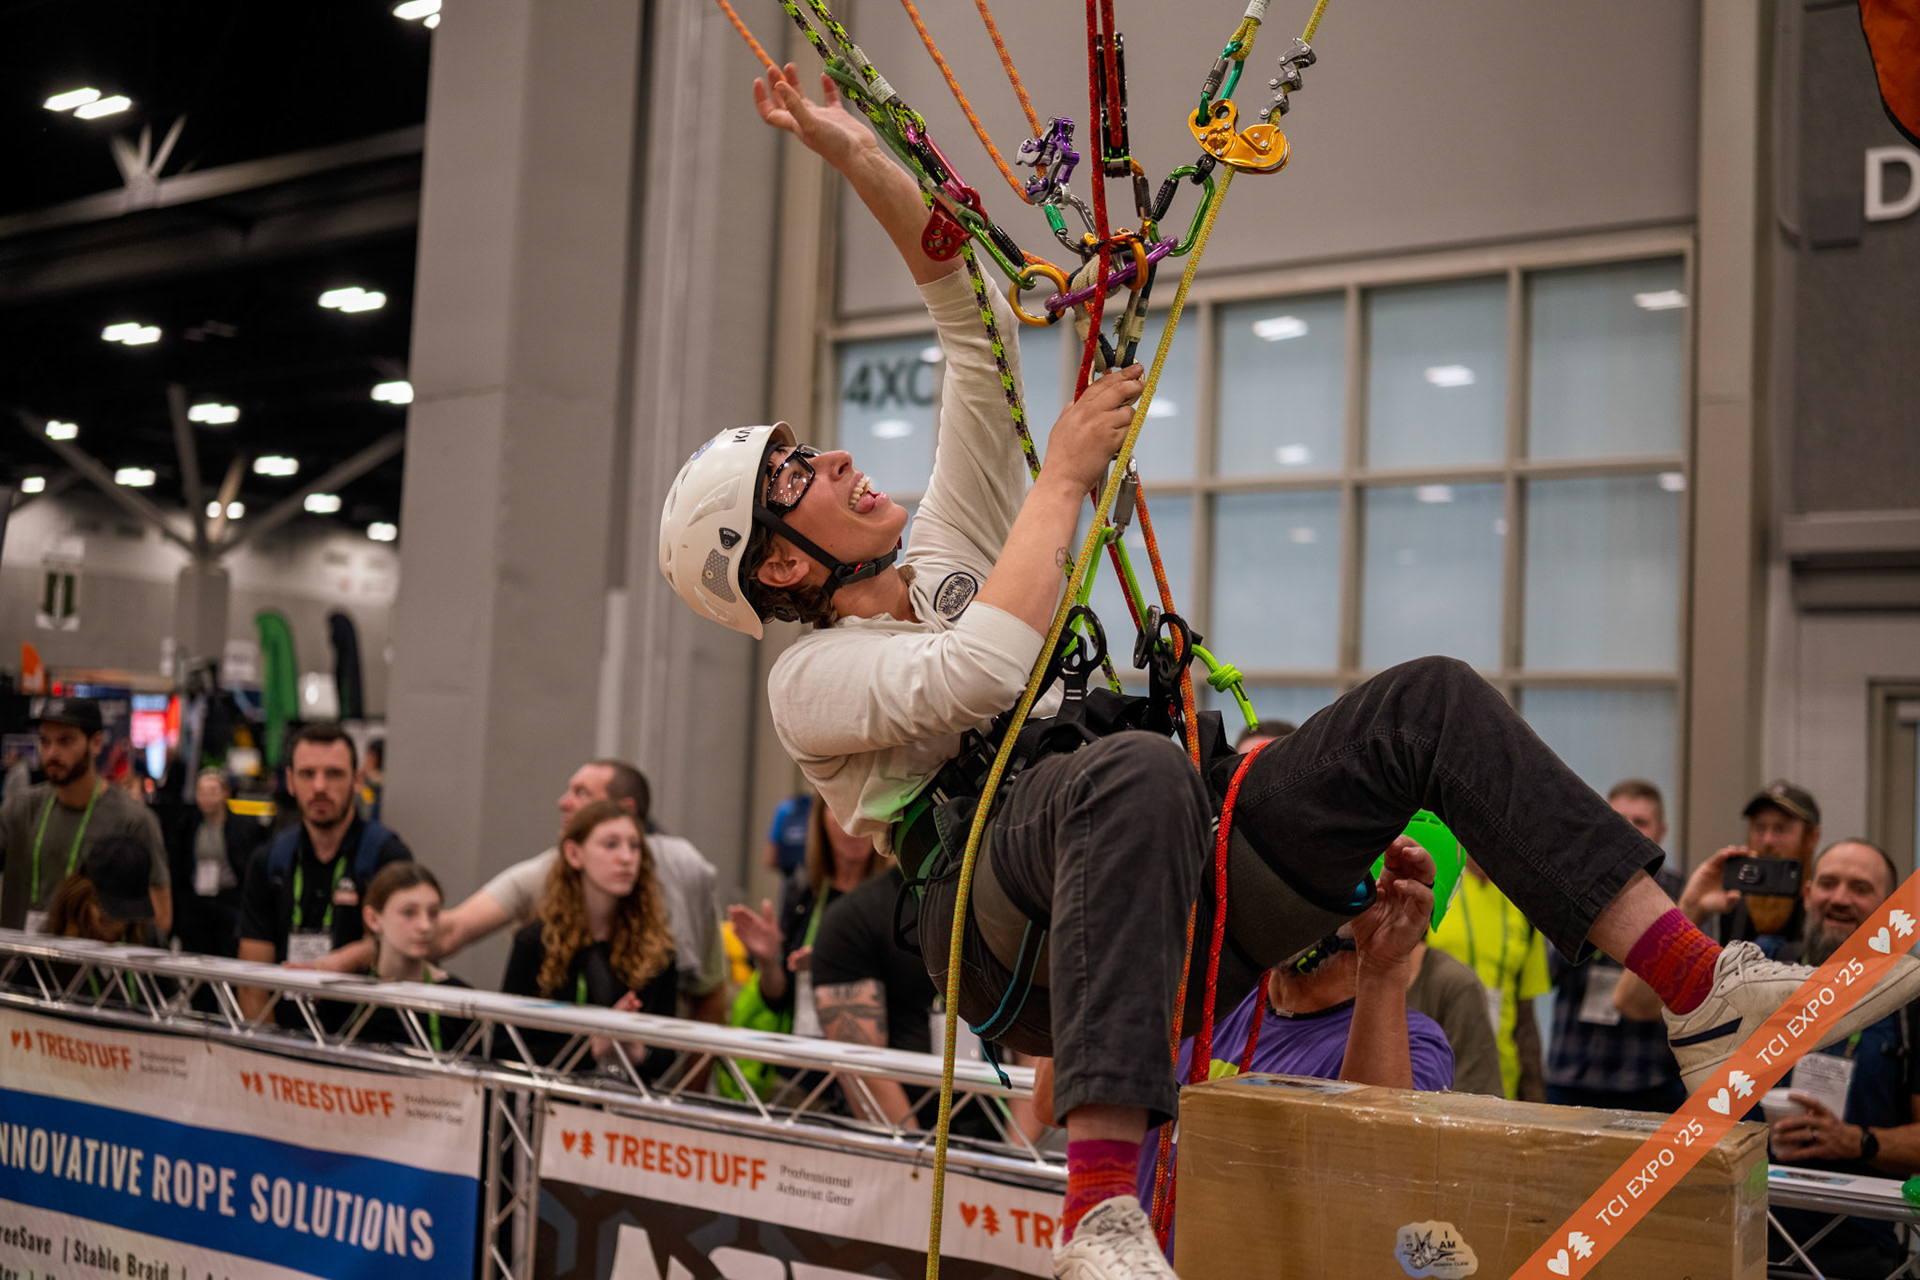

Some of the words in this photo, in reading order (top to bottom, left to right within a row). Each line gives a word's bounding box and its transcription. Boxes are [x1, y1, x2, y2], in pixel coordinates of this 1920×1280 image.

[1864, 146, 1920, 221] D
[36, 1030, 133, 1072] TREESTUFF
[268, 1073, 397, 1118] TREESTUFF
[604, 1131, 767, 1191] TREESTUFF
[152, 1153, 237, 1218] ROPE
[250, 1173, 434, 1261] SOLUTIONS
[1008, 1208, 1063, 1250] TR
[1440, 1240, 1456, 1249] AM
[73, 1238, 120, 1274] Stable
[127, 1252, 169, 1280] Braid
